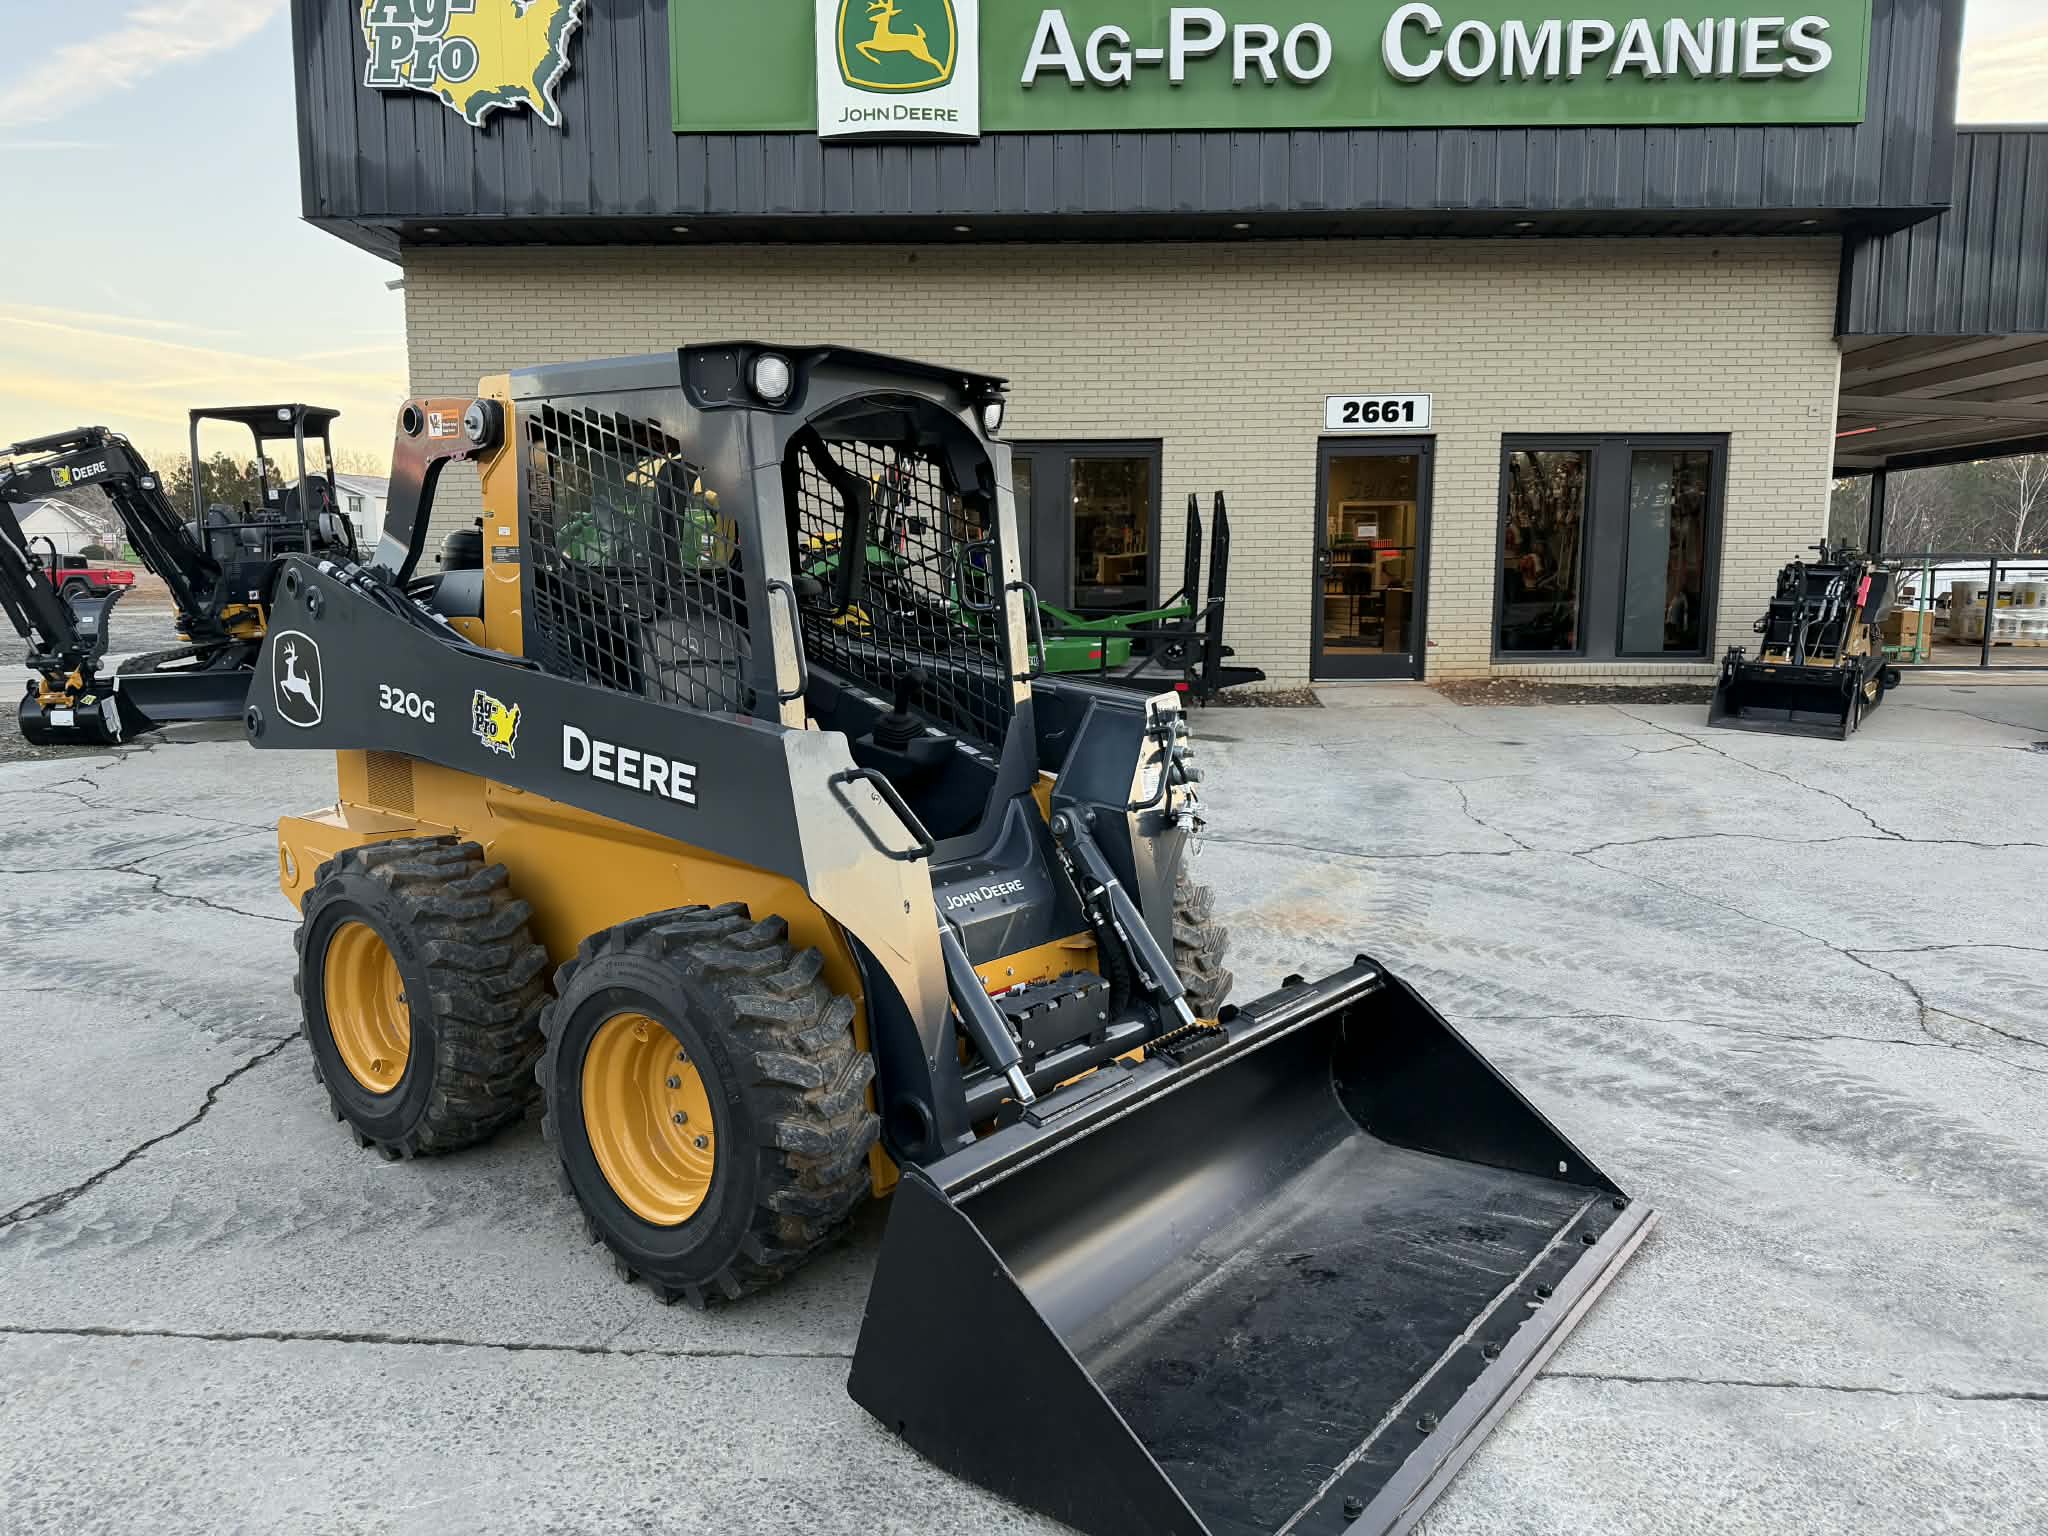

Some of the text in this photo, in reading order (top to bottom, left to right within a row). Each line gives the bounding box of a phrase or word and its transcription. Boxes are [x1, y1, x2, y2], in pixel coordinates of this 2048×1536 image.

[370, 25, 477, 82] Pro
[1020, 2, 1833, 88] AG-PRO COMPANIES
[838, 105, 958, 122] JOHN DEERE
[1342, 400, 1415, 423] 2661
[71, 461, 107, 481] DEERE
[379, 684, 436, 724] 320G
[475, 713, 498, 736] Pro
[563, 724, 697, 805] DEERE
[946, 880, 1025, 910] JOHN DEERE
